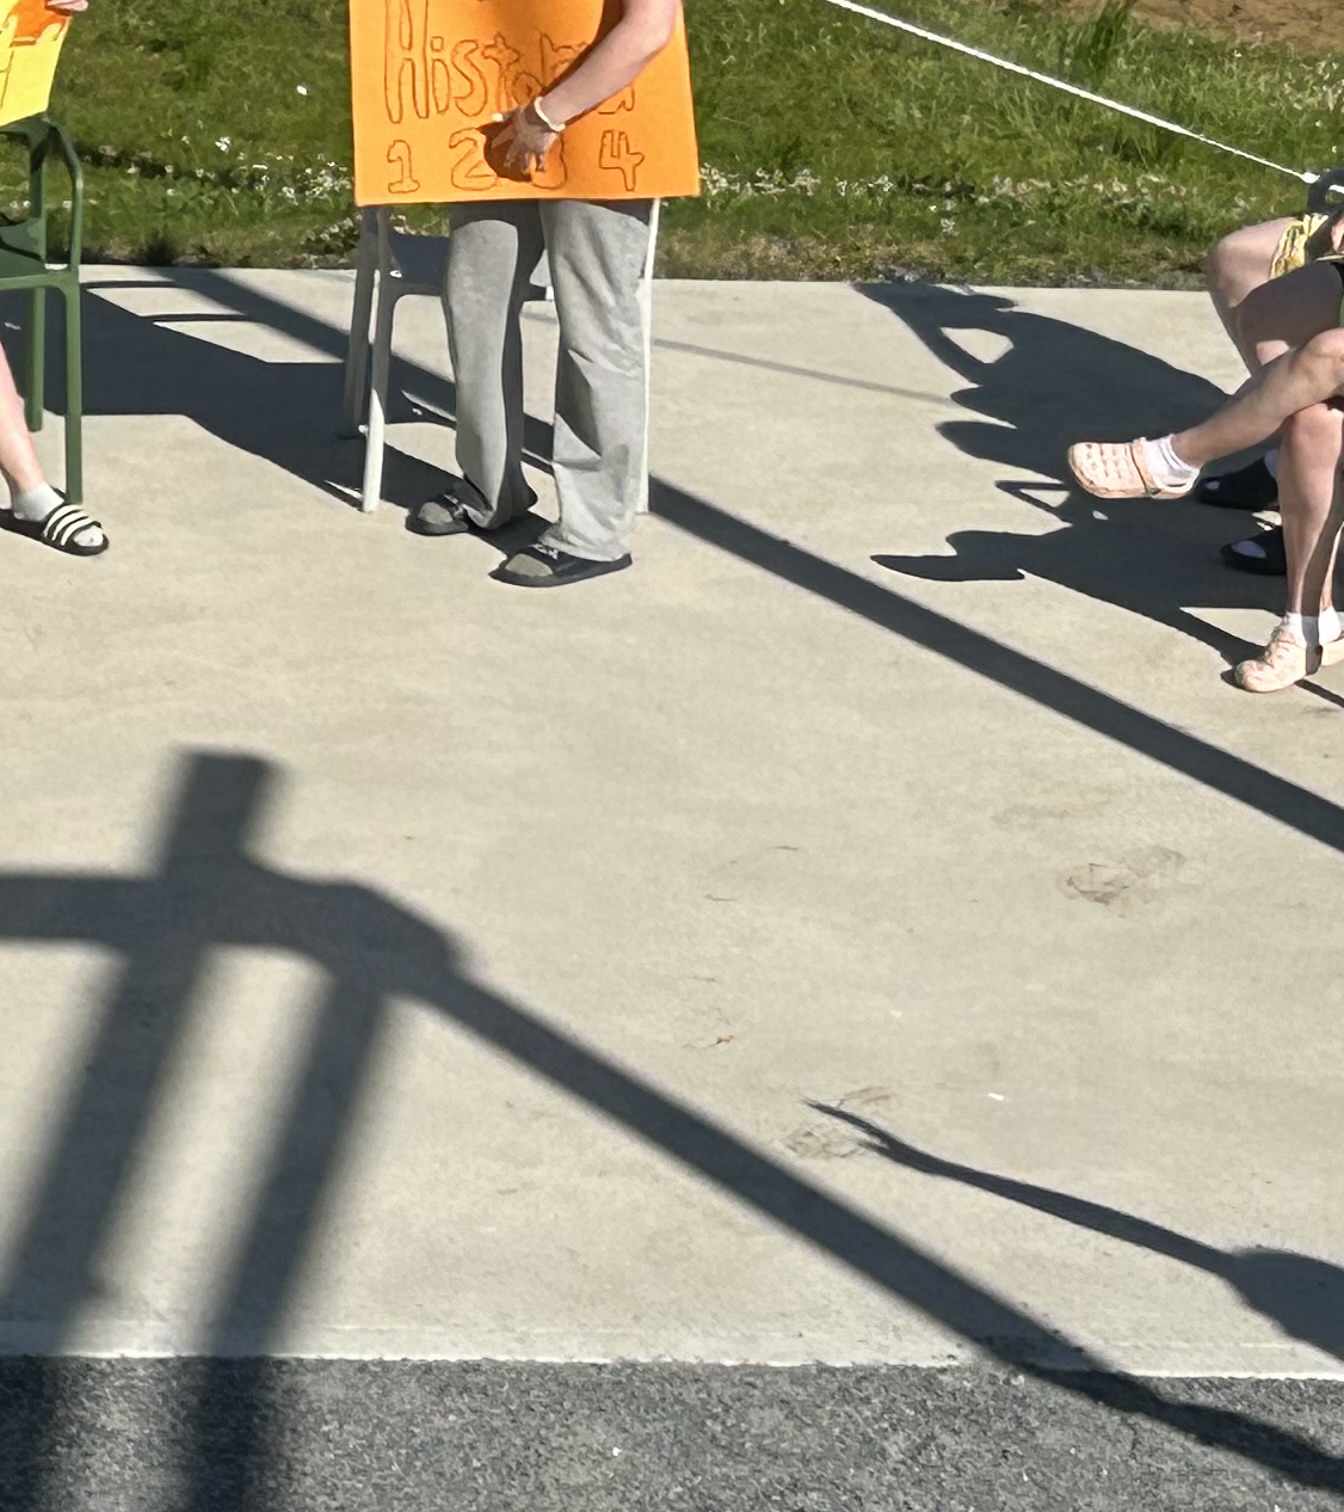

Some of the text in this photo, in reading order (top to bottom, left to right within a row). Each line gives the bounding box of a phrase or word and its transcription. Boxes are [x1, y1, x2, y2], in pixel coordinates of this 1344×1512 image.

[387, 139, 421, 194] 1
[448, 127, 498, 191] 2
[598, 129, 646, 192] 4
